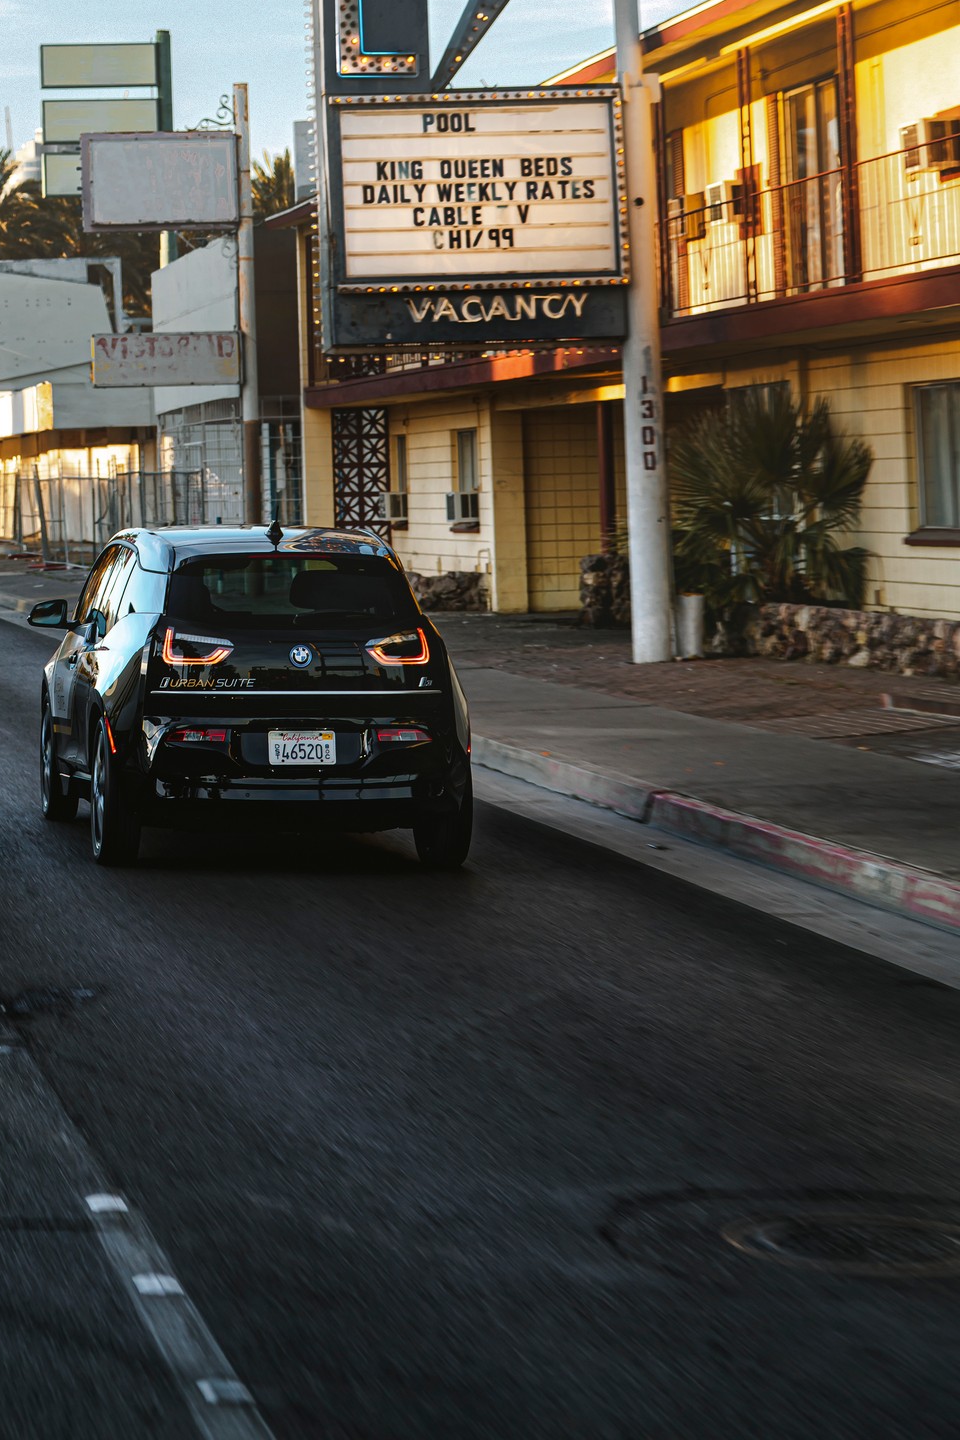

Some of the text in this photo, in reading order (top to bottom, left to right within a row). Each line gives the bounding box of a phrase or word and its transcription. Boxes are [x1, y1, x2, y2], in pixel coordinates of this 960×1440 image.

[422, 112, 476, 133] POOL
[376, 156, 573, 181] KING QUEEN BEDS
[362, 179, 595, 204] DAILY WEEKLY RATES
[413, 206, 482, 227] CABLE
[406, 292, 588, 323] VACANCY
[641, 376, 656, 471] 1300
[282, 733, 319, 743] California
[282, 743, 323, 759] 46520
